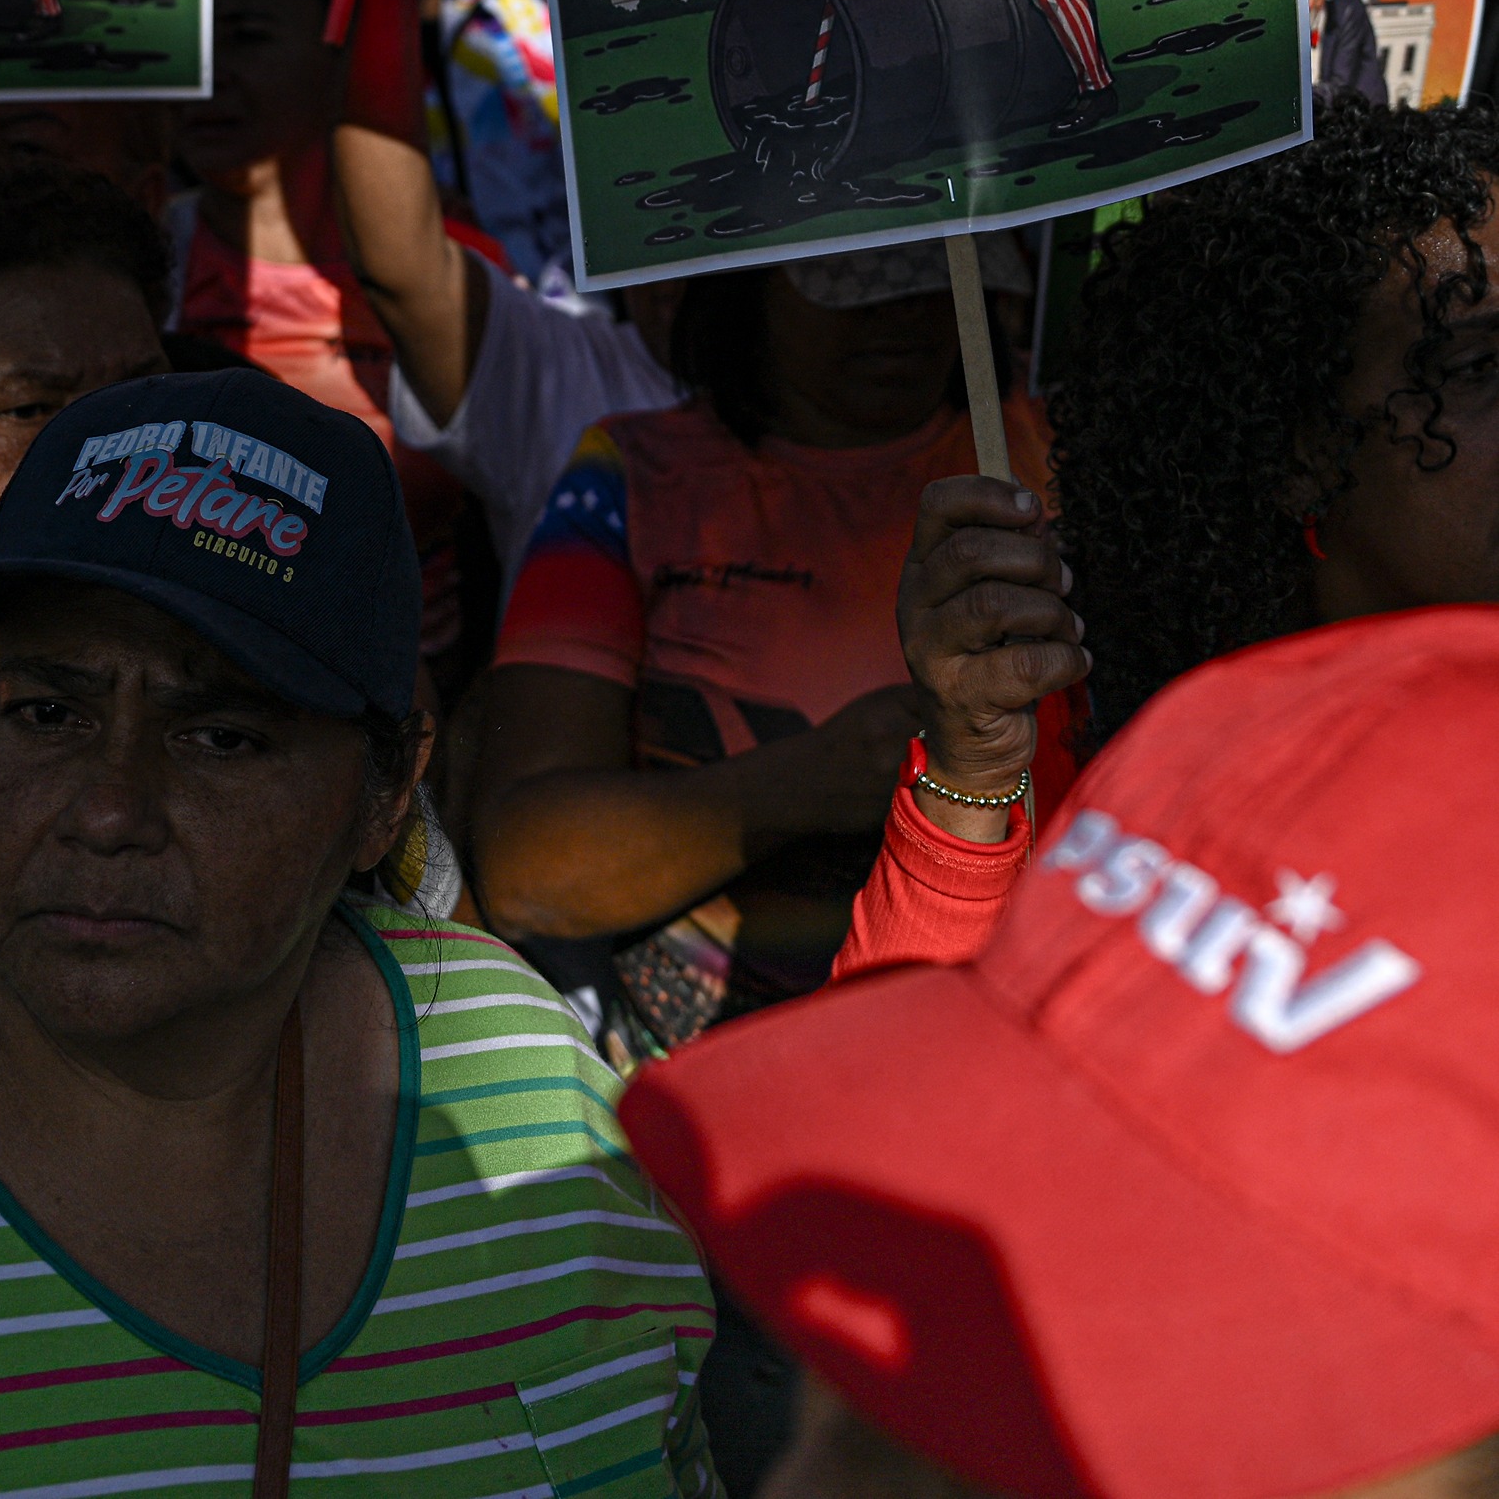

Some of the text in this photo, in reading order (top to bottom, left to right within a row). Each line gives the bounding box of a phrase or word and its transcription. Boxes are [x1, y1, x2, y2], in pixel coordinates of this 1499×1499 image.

[55, 449, 308, 556] Por Petare
[73, 420, 328, 514] PEDRO INFANTE
[193, 530, 295, 584] CIRCUITO 3
